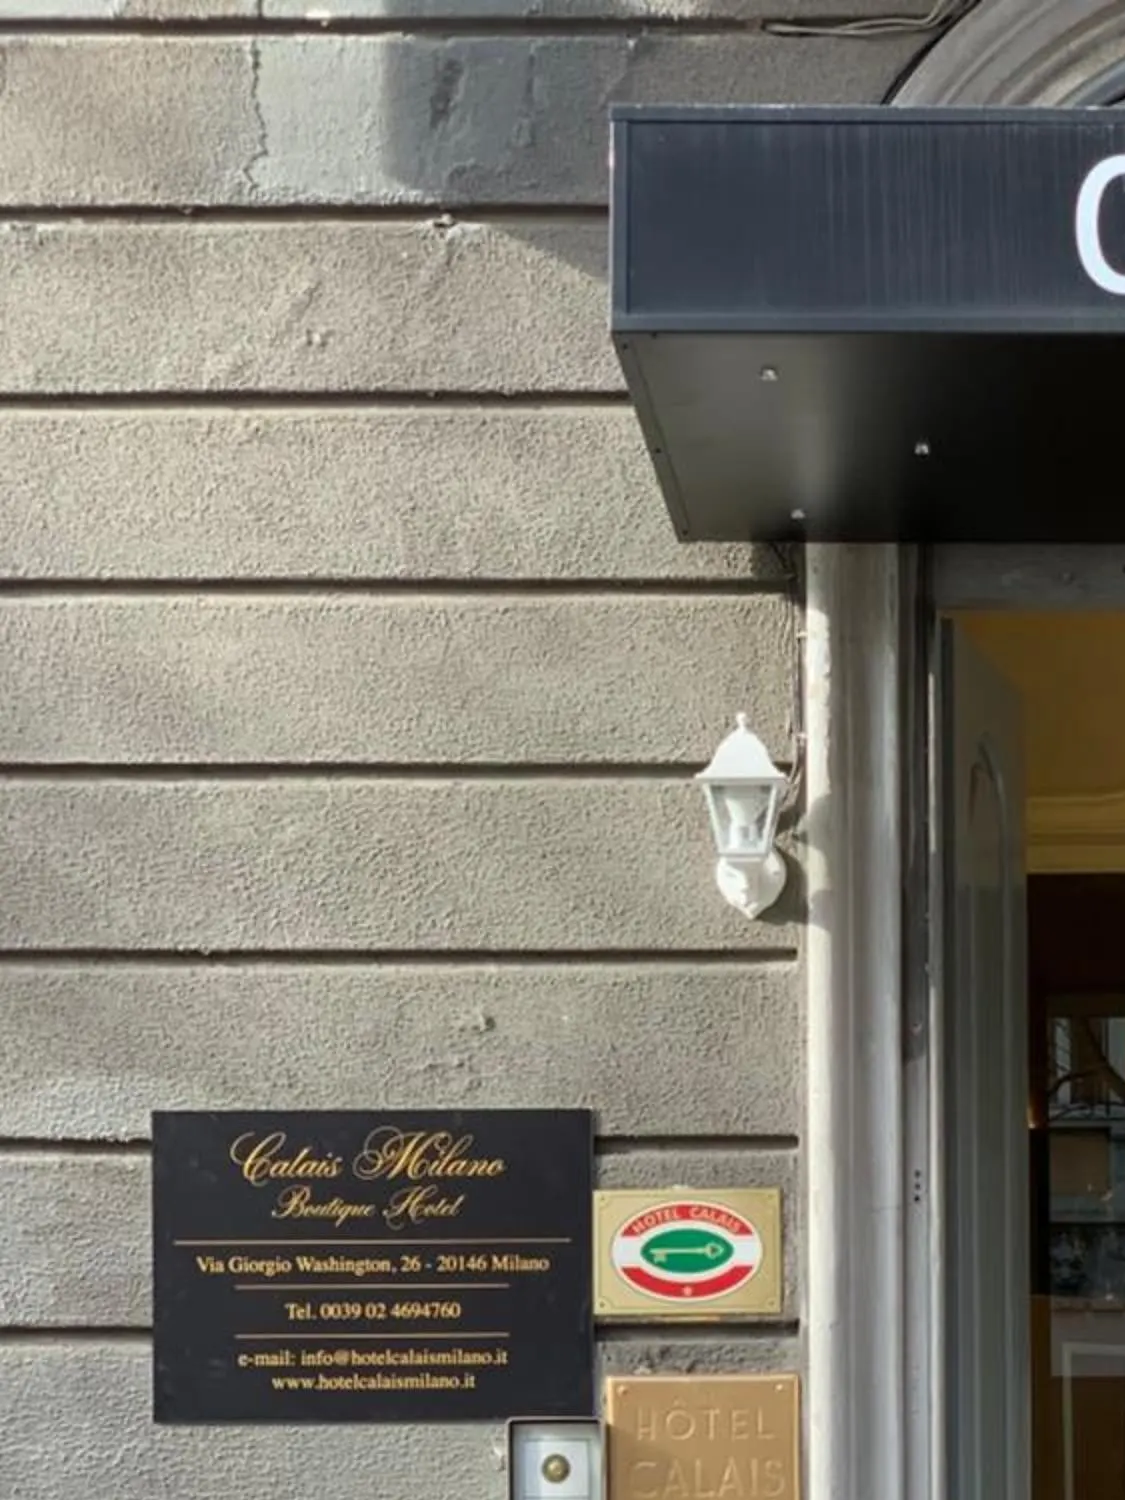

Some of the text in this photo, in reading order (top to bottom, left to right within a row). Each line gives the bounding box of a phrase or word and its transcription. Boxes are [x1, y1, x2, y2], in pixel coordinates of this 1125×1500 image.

[230, 1126, 506, 1186] Calais Milano
[271, 1185, 464, 1230] Boutique Hotel
[688, 1206, 742, 1232] CALAIS
[196, 1255, 225, 1273] Via
[228, 1255, 292, 1277] Giorgio
[296, 1255, 398, 1277] Washington,
[400, 1255, 422, 1273] 26
[436, 1254, 488, 1273] 20146
[491, 1254, 550, 1272] Milano
[284, 1302, 462, 1320] Tel. 0039 02 4694760
[237, 1348, 508, 1368] e-mail: info@hotelcalaismilano.it
[271, 1373, 476, 1390] www.hotelcalaismilano.it
[636, 1398, 776, 1441] HÔTEL
[629, 1459, 786, 1500] CALAIS
